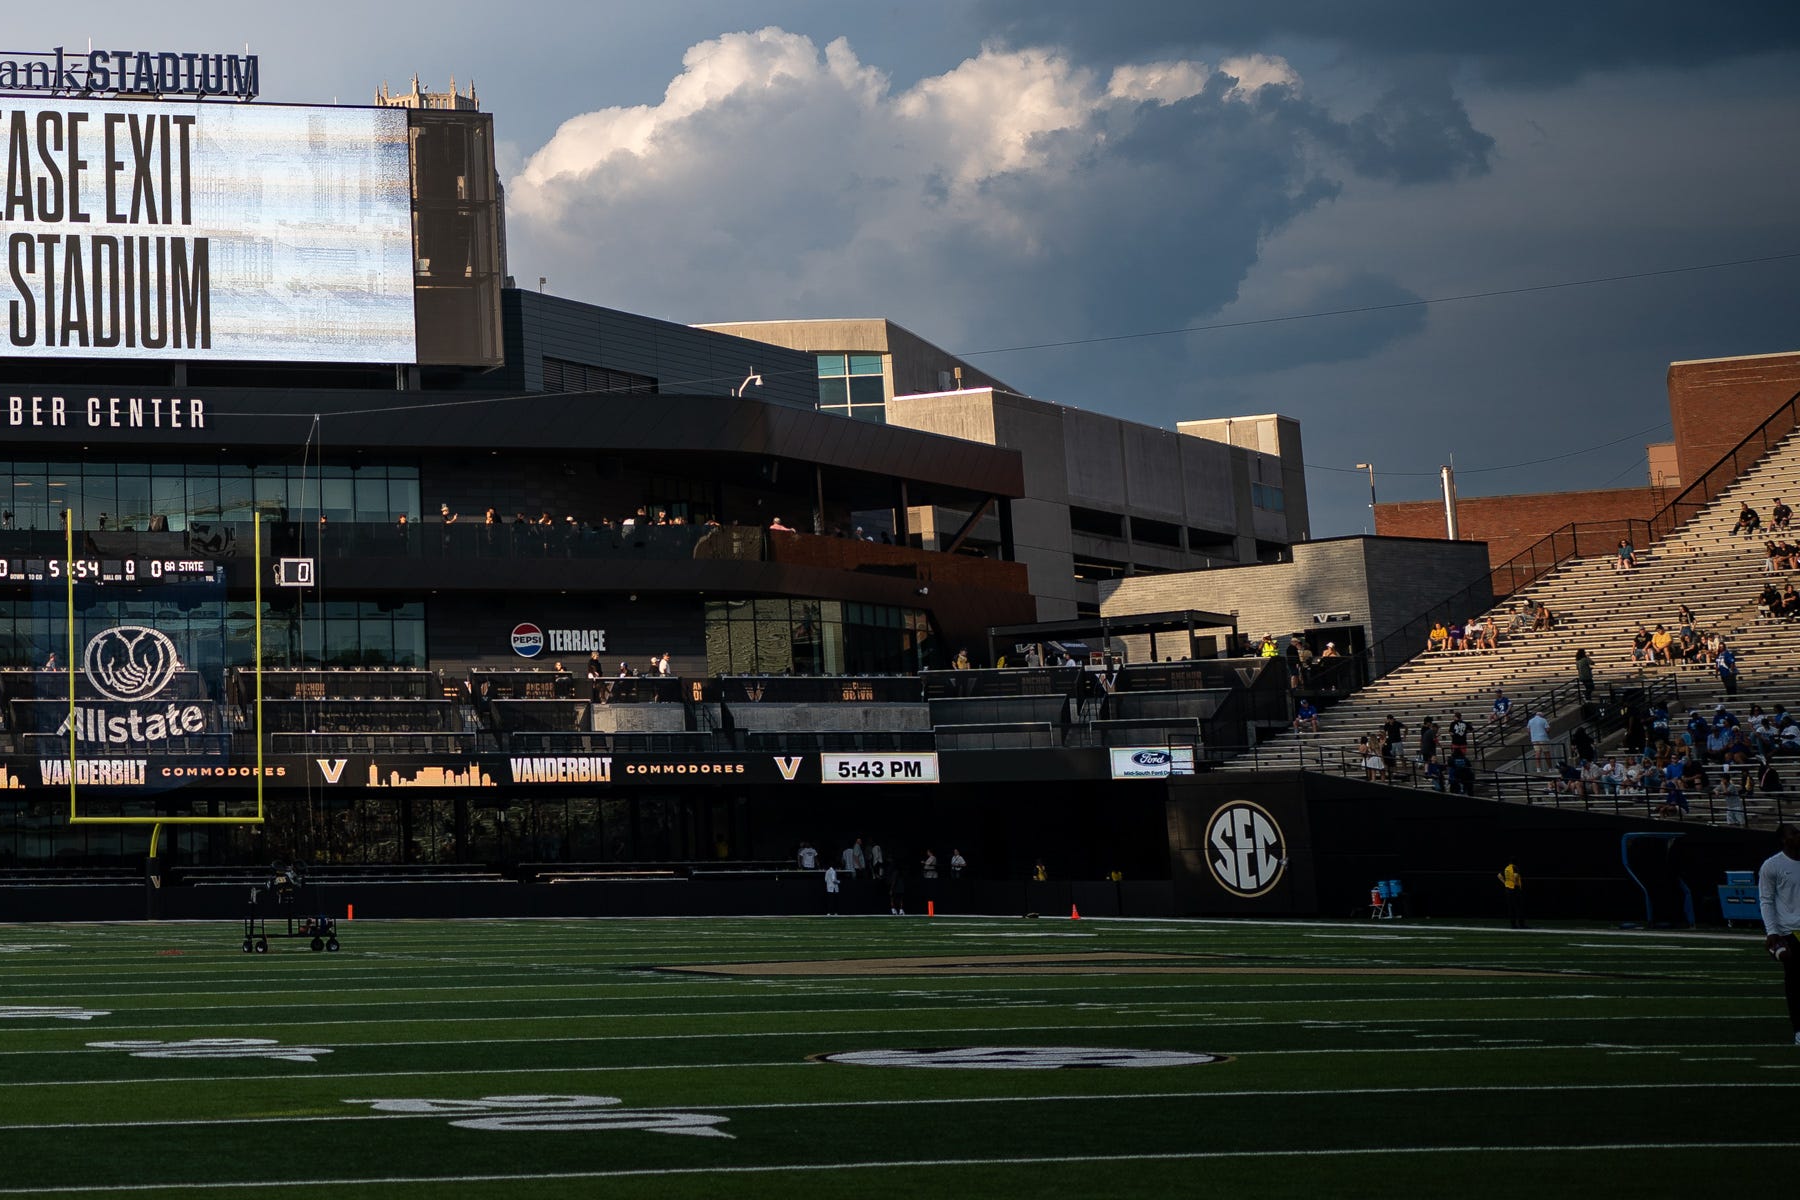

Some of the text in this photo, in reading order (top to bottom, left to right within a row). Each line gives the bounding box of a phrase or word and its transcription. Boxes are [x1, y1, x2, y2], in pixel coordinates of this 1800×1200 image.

[88, 50, 260, 97] STADIUM
[104, 113, 196, 225] EXIT
[8, 233, 212, 349] STADIUM
[87, 398, 204, 428] CENTER
[179, 561, 205, 572] STATE
[513, 630, 606, 652] PEPSI TERRACE
[56, 703, 204, 743] Allstate
[40, 759, 286, 786] VANDERBILT COMMODORES
[510, 757, 745, 783] VANDERBILT COMMODORES
[837, 760, 922, 779] 5:43 PM
[1140, 753, 1165, 764] Ford
[1211, 808, 1278, 890] SEC
[340, 1094, 732, 1132] 20
